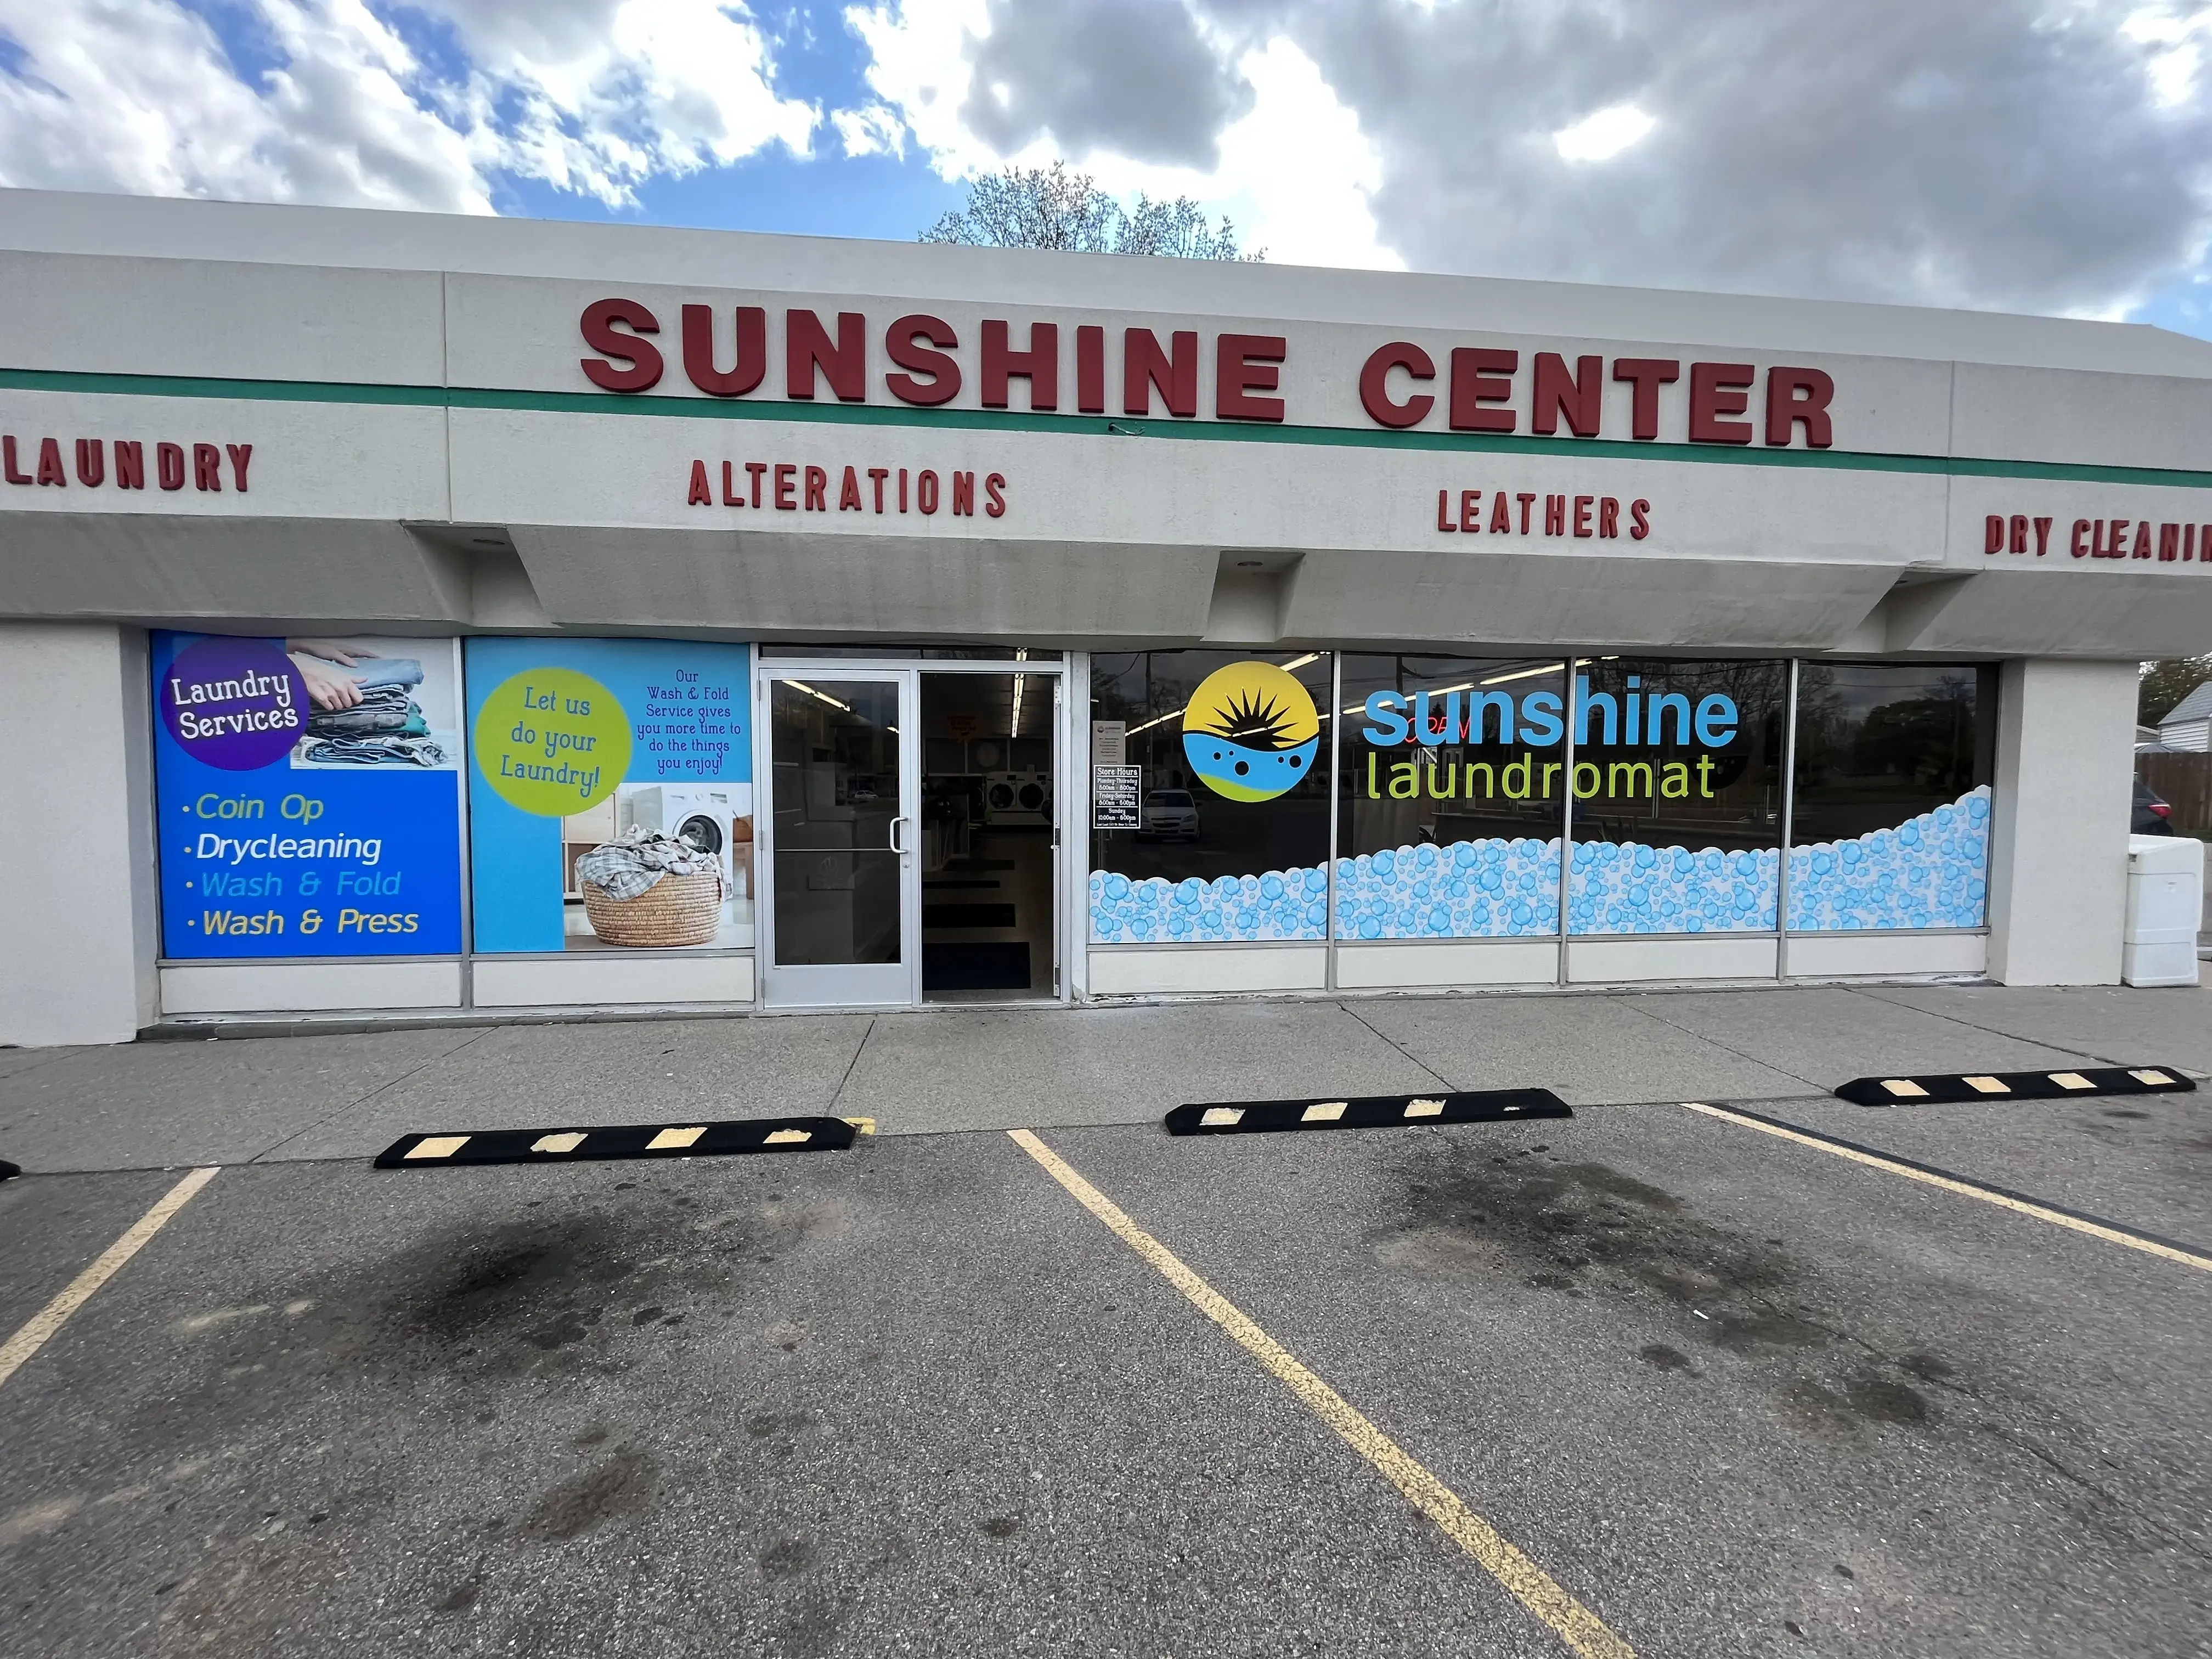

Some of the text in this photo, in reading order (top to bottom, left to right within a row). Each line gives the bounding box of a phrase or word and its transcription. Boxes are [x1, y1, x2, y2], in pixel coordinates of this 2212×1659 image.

[580, 298, 1835, 448] SUNSHINE CENTER
[2, 435, 253, 492] LAUNDRY
[688, 459, 1006, 518] ALTERATIONS
[1438, 490, 1650, 540] LEATHERS
[1984, 515, 2053, 556] DRY
[171, 669, 290, 707] Laundry
[676, 669, 699, 682] Our
[524, 687, 591, 716] Let us
[646, 686, 729, 700] Wash & Fold
[179, 707, 298, 739] Services
[646, 703, 731, 724] Service gives
[1363, 675, 1738, 747] sunshine
[511, 721, 597, 758] do your
[637, 722, 741, 740] you more time to
[649, 738, 730, 758] do the things
[501, 754, 600, 798] Laundry!
[657, 759, 680, 775] you
[1367, 752, 1714, 800] laundromat
[196, 793, 324, 825] Coin Op
[196, 833, 382, 865] Drycleaning
[201, 871, 402, 896] Wash & Fold
[203, 909, 419, 935] Wash & Press
